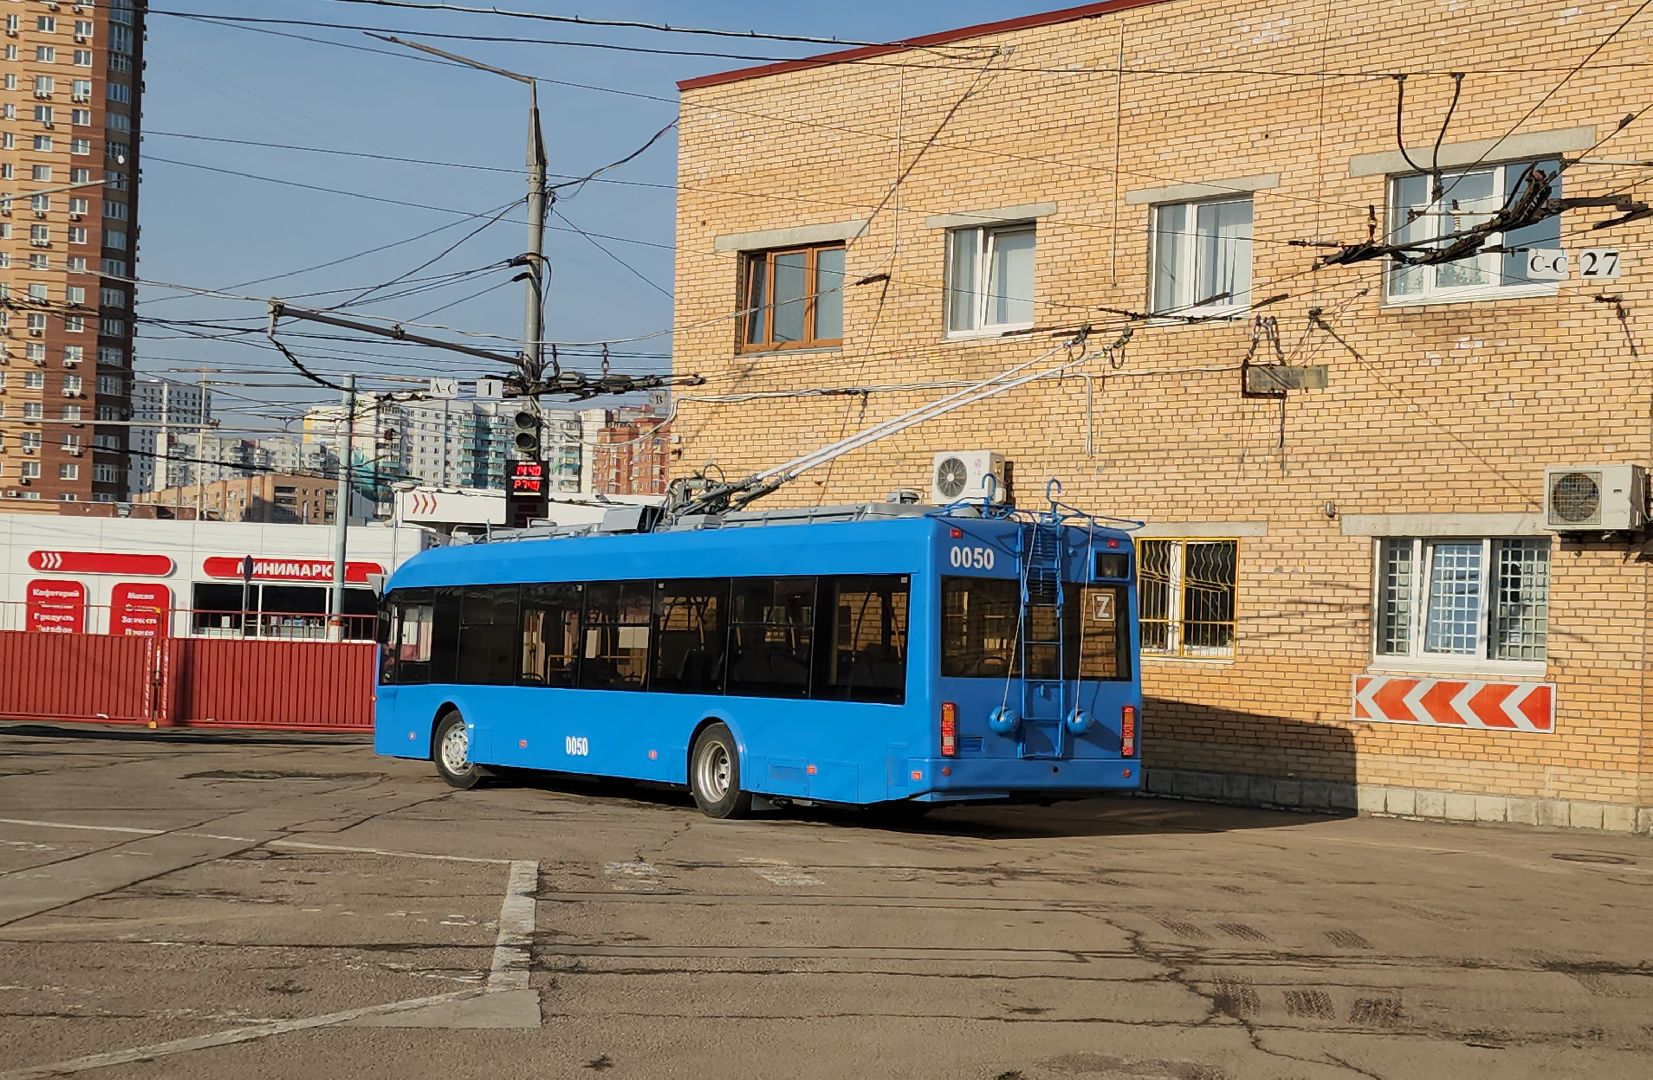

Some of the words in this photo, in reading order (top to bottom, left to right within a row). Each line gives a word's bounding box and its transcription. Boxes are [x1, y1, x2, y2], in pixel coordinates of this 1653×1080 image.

[1581, 252, 1620, 276] 27
[484, 381, 492, 396] 1
[950, 546, 995, 570] 0050
[236, 561, 349, 578] МИНИМАРК
[1096, 596, 1110, 618] Z
[565, 735, 589, 757] 0050
